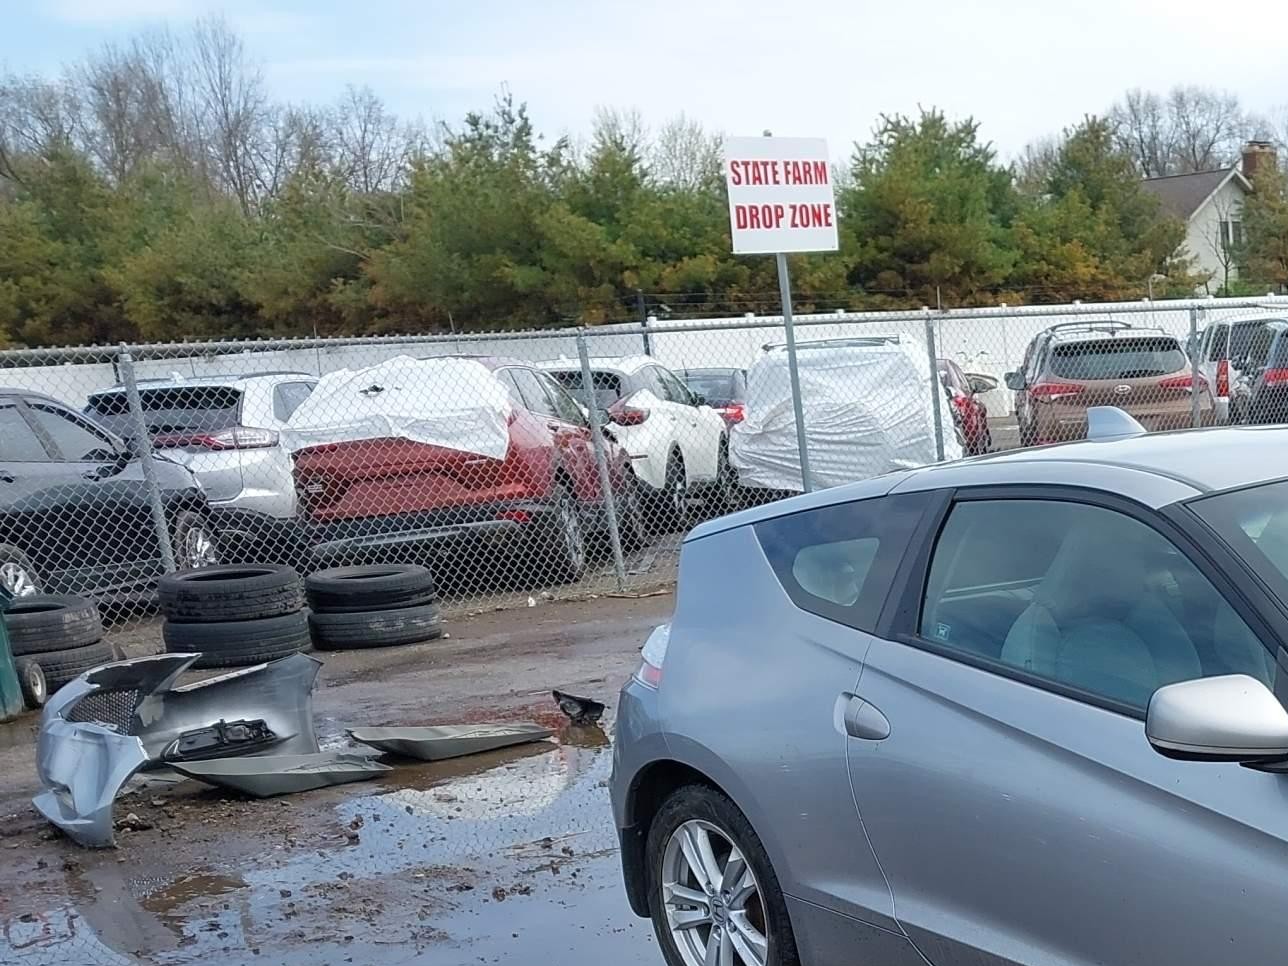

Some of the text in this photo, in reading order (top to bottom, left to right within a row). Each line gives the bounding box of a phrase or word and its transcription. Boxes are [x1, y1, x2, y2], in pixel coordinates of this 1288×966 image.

[730, 160, 828, 185] STATE FARM
[735, 203, 833, 230] DROP ZONE
